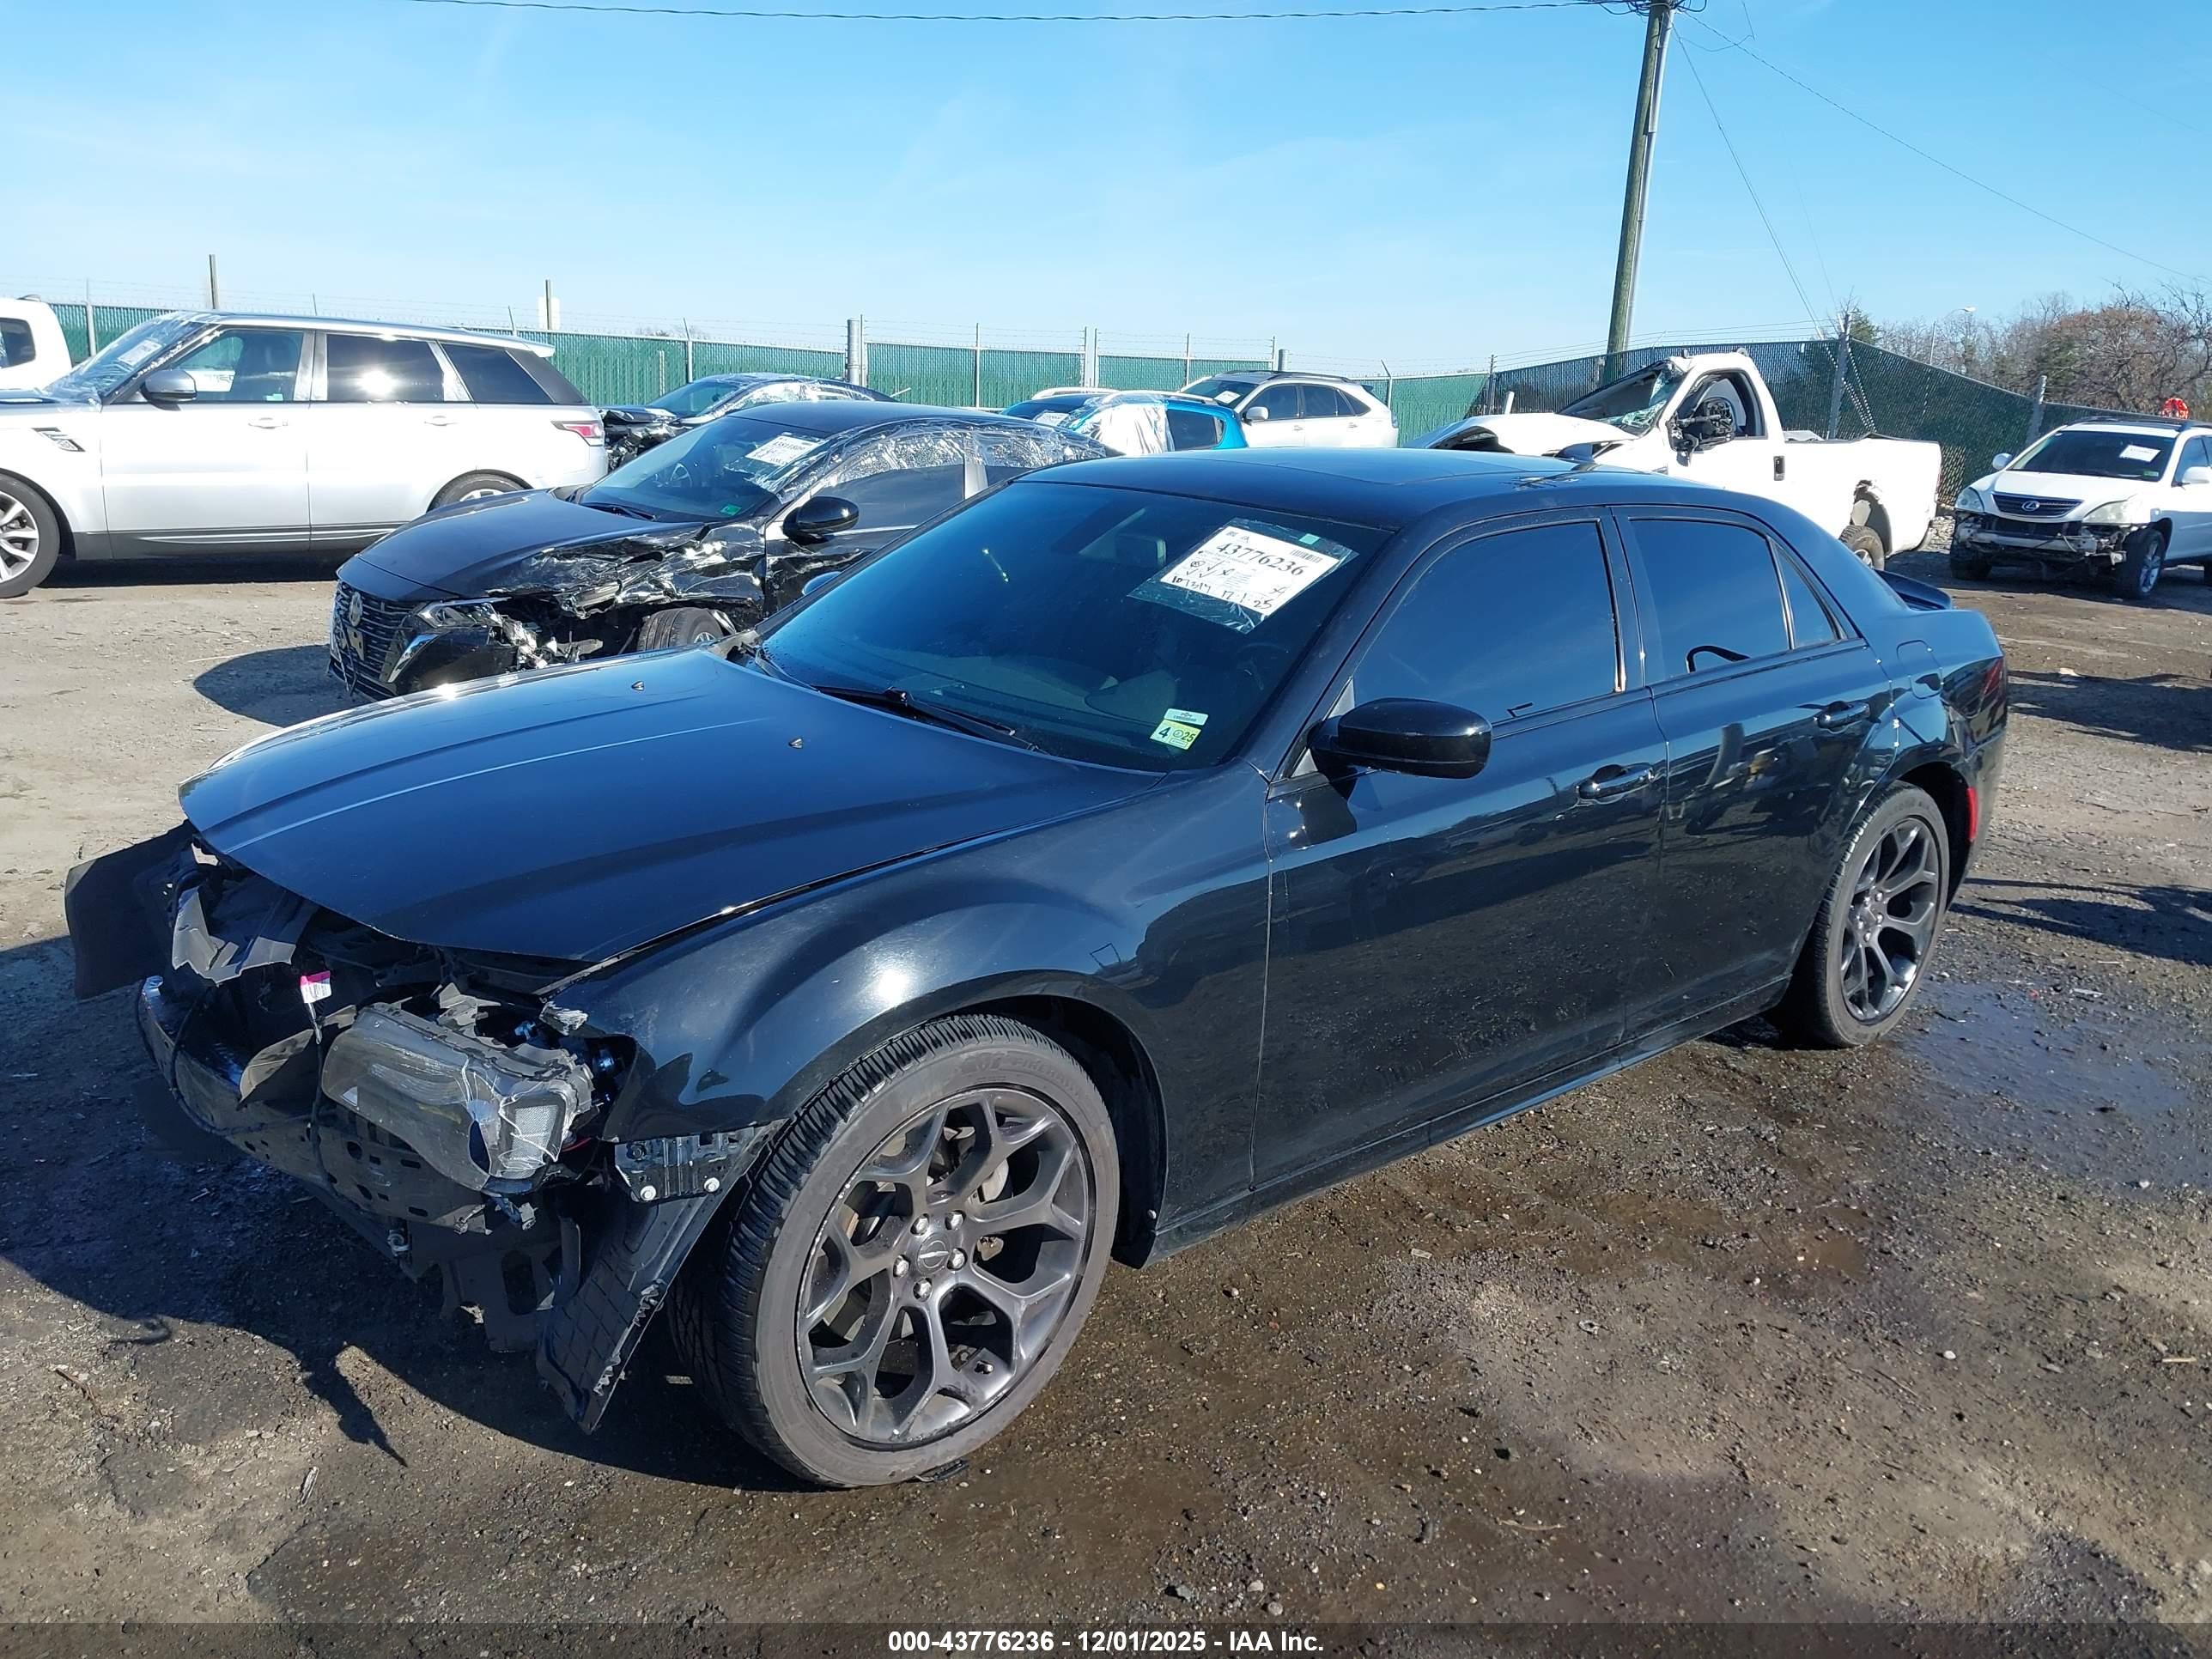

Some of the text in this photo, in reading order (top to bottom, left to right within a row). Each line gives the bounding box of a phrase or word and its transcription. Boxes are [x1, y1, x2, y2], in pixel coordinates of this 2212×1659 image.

[1216, 541, 1305, 577] 43776236
[1158, 726, 1171, 738] 4
[1181, 732, 1196, 743] 25
